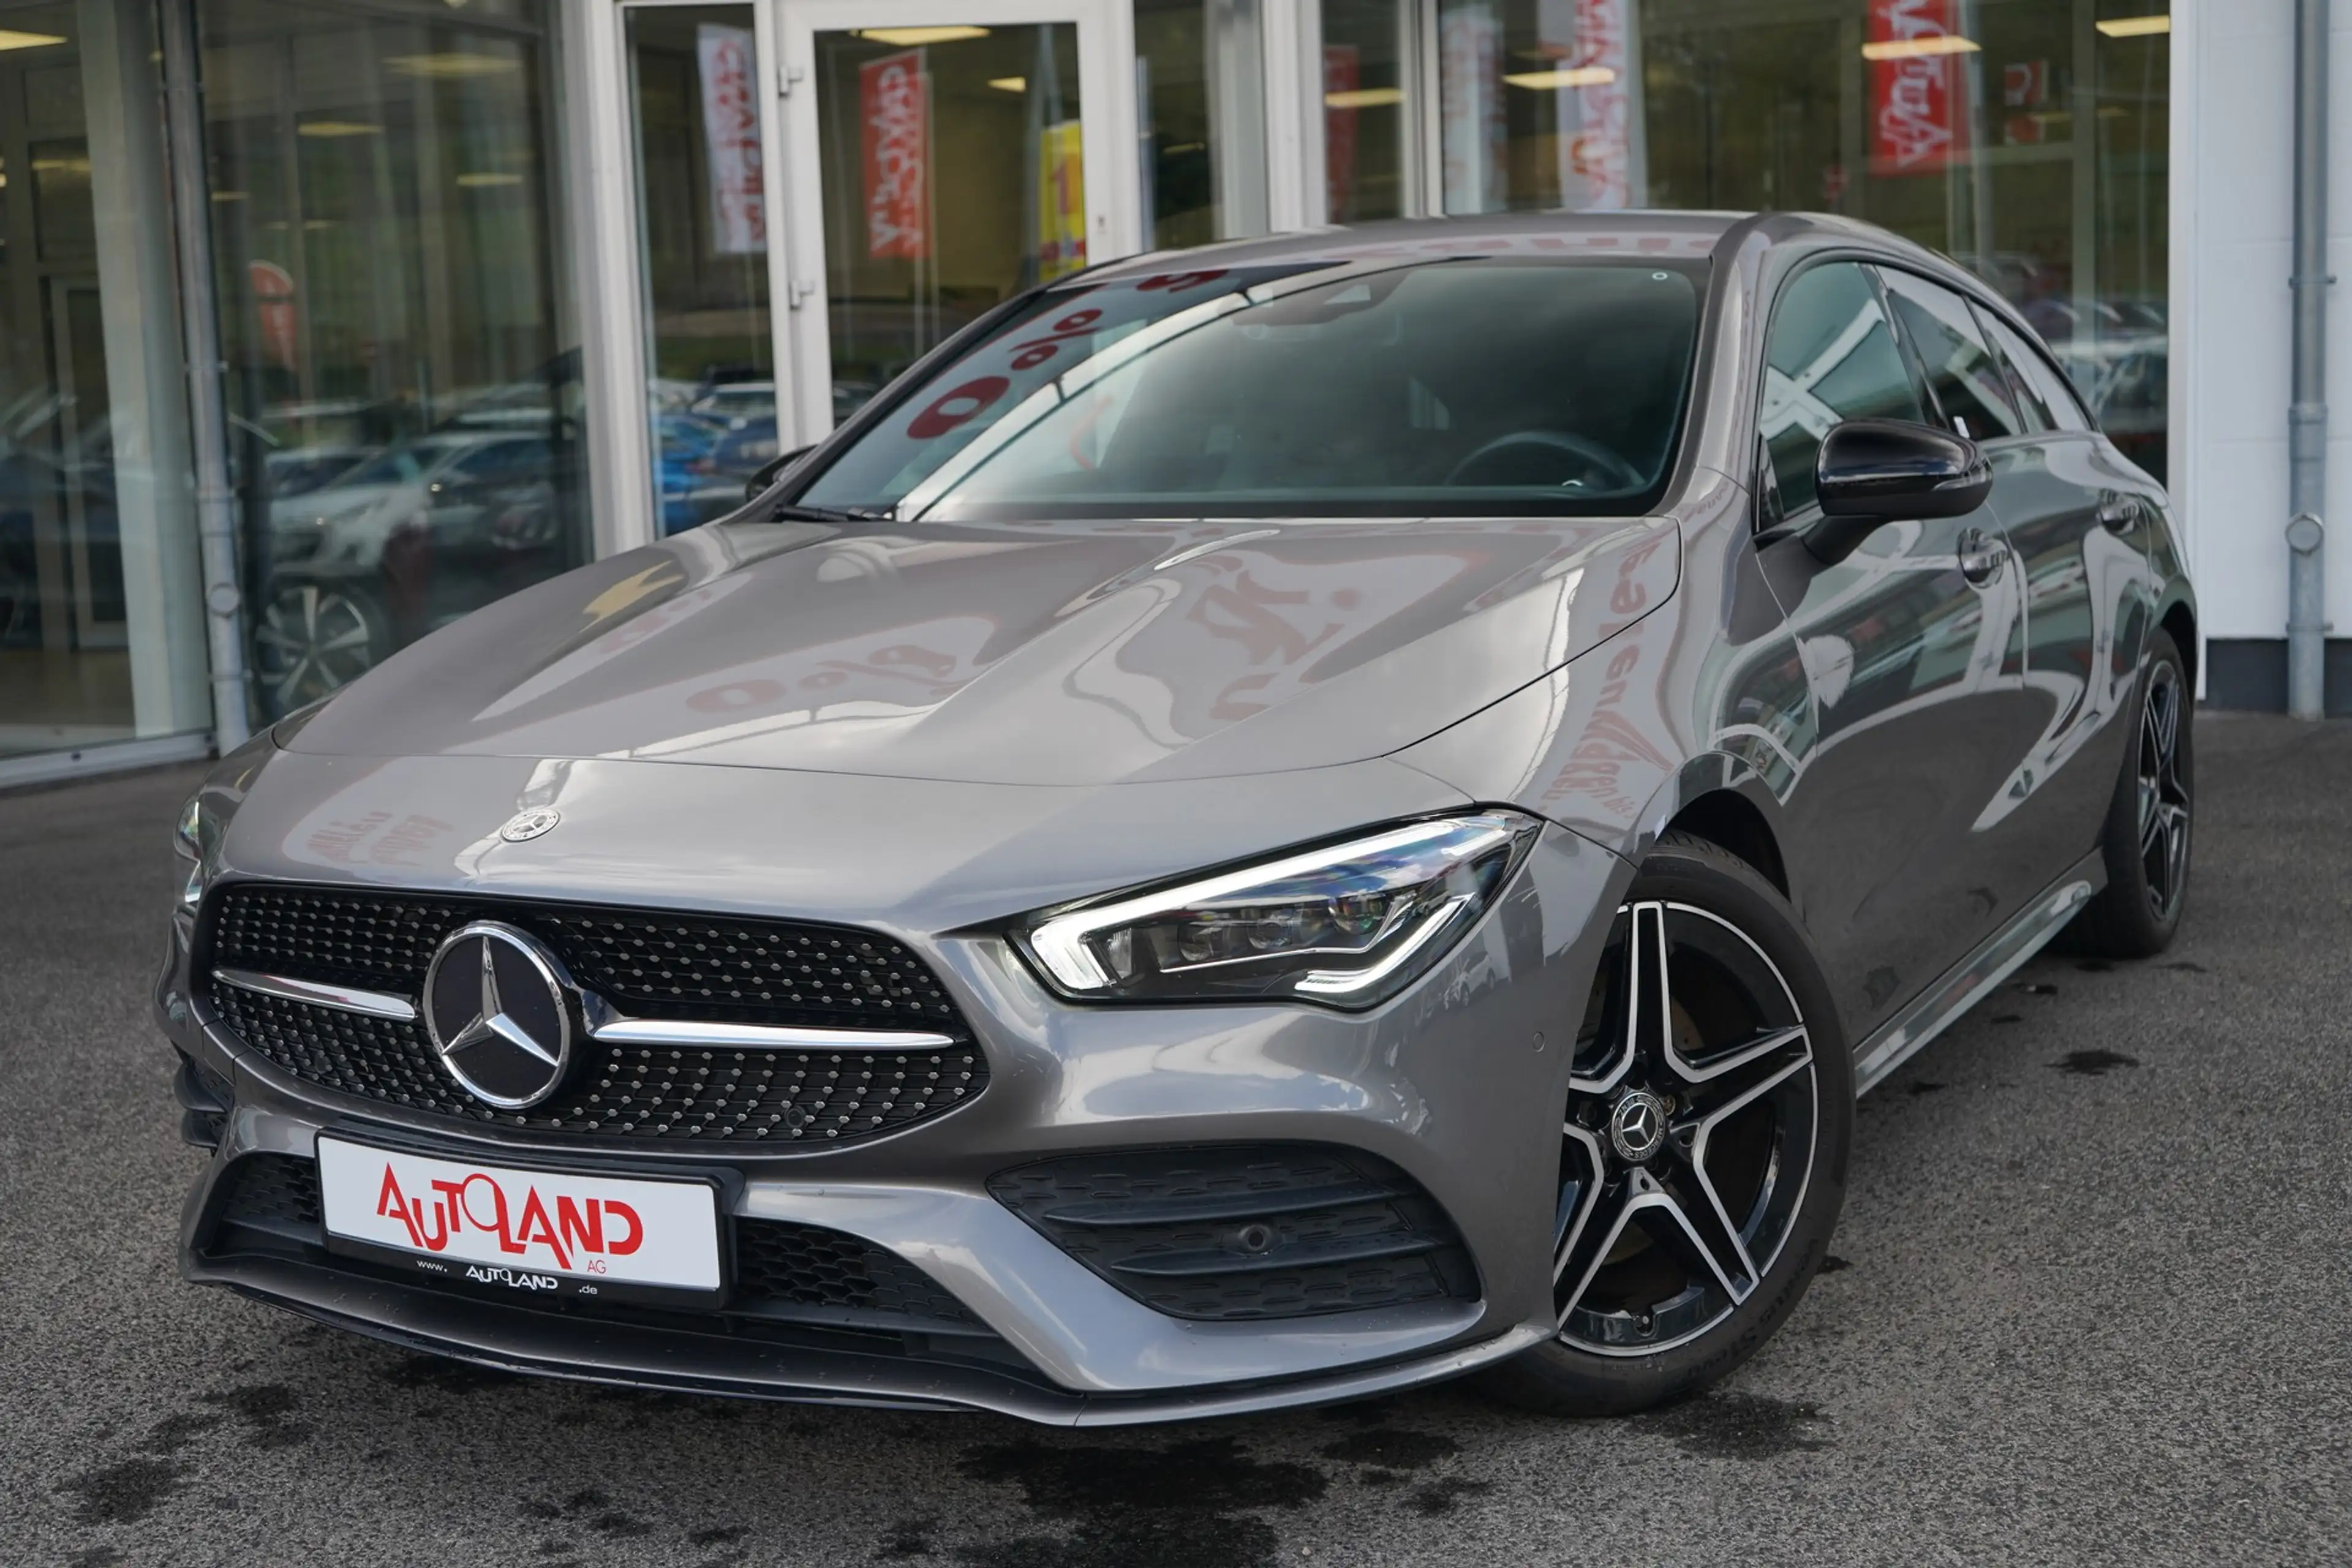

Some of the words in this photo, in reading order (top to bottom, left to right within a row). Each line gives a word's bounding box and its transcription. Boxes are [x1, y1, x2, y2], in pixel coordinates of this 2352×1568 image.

[376, 1161, 643, 1270] AUTOLAND
[417, 1260, 448, 1273] www.
[466, 1265, 559, 1291] AUTOLAND
[578, 1285, 598, 1294] .de
[587, 1260, 607, 1274] AG
